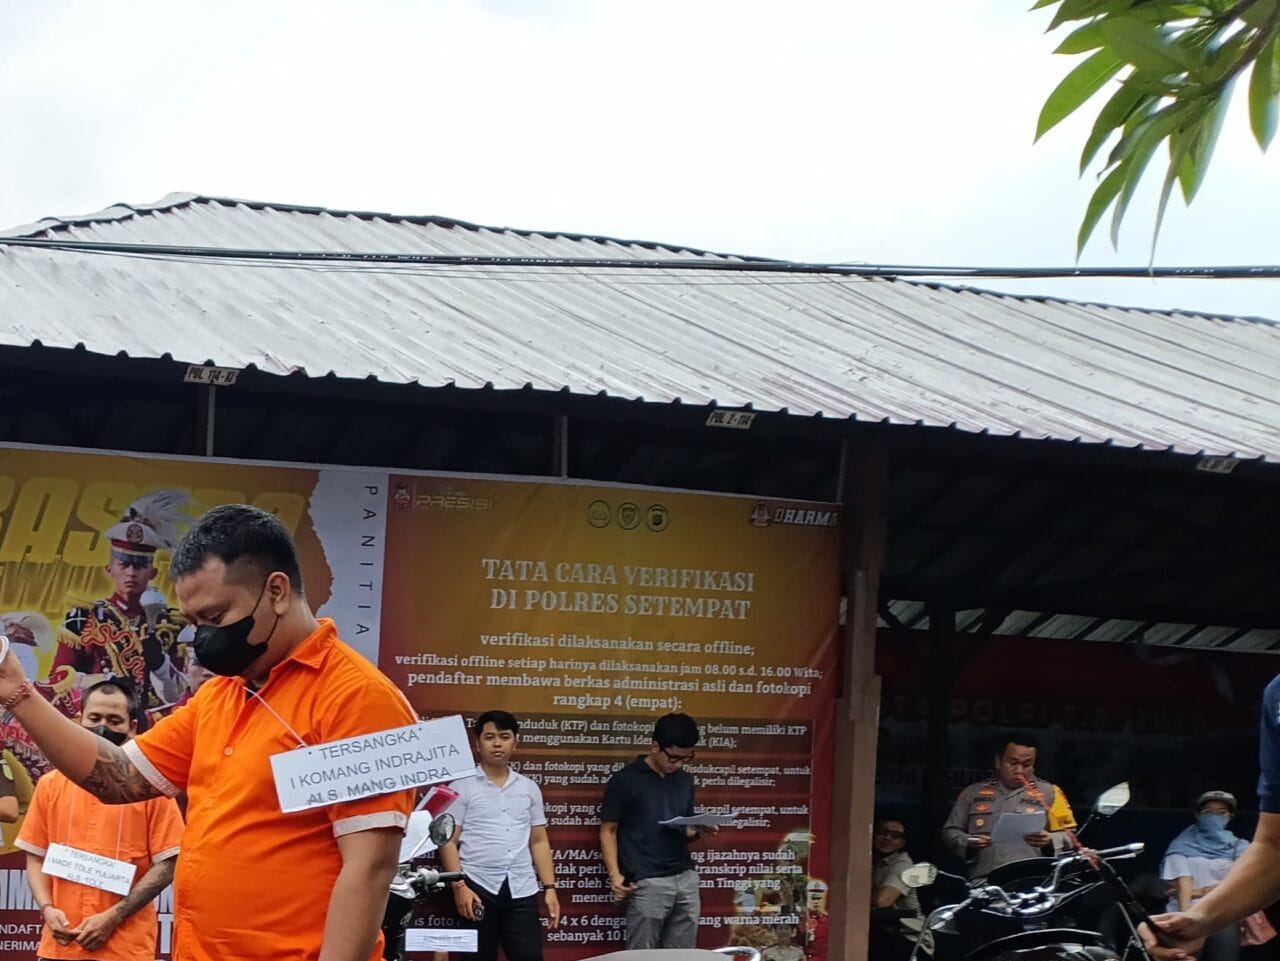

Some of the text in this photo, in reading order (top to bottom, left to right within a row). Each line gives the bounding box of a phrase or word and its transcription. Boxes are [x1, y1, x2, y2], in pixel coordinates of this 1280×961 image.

[356, 486, 378, 635] PANITIA
[482, 558, 755, 592] TATA CARA VERIFIKASI
[490, 588, 751, 620] DI POLRES SETEMPAT
[480, 632, 755, 657] verifikasi dilaksanakan secara offline;
[395, 653, 458, 666] verifikasi
[461, 655, 505, 668] offline
[507, 657, 546, 671] setiap
[549, 658, 596, 673] harinya
[599, 660, 678, 674] dilaksanakan
[680, 665, 702, 677] jam
[704, 664, 736, 676] 08.00
[760, 666, 792, 677] 16.00
[407, 671, 811, 698] pendaftar membawa berkas administrasi asli dan fotokopi
[552, 693, 682, 710] rangkap 4 (empat):
[560, 718, 588, 732] (KTP)
[590, 719, 611, 731] dan
[708, 723, 739, 735] belum
[741, 723, 786, 735] memiliki
[787, 725, 808, 736] KTP
[319, 729, 420, 760] TERSANGKA
[522, 734, 600, 746] menggunakan
[601, 734, 631, 745] Kartu
[290, 743, 461, 789] I KOMANG INDRAJITA
[522, 761, 542, 771] dan
[544, 761, 585, 774] fotokopi
[586, 763, 611, 775] yang
[783, 766, 812, 776] untuk
[347, 777, 397, 799] MANG
[401, 766, 452, 787] INDRA
[544, 775, 569, 786] yang
[570, 774, 600, 784] sudah
[701, 777, 726, 788] perlu
[545, 802, 568, 815] kopi
[569, 804, 599, 816] yang
[694, 804, 730, 816] ukcapil
[780, 804, 809, 815] untuk
[550, 816, 583, 826] sudah
[707, 849, 761, 863] ijazahnya
[762, 849, 796, 861] sudah
[748, 863, 774, 874] nilai
[775, 864, 803, 875] serta
[577, 877, 602, 889] oleh
[716, 877, 752, 891] Tinggi
[752, 880, 781, 891] yang
[560, 915, 568, 926] 4
[569, 917, 578, 926] x
[580, 915, 589, 926] 6
[590, 915, 627, 929] denga
[723, 915, 760, 925] warna
[761, 913, 800, 925] merah
[546, 930, 604, 944] sebanyak
[606, 930, 621, 941] 10
